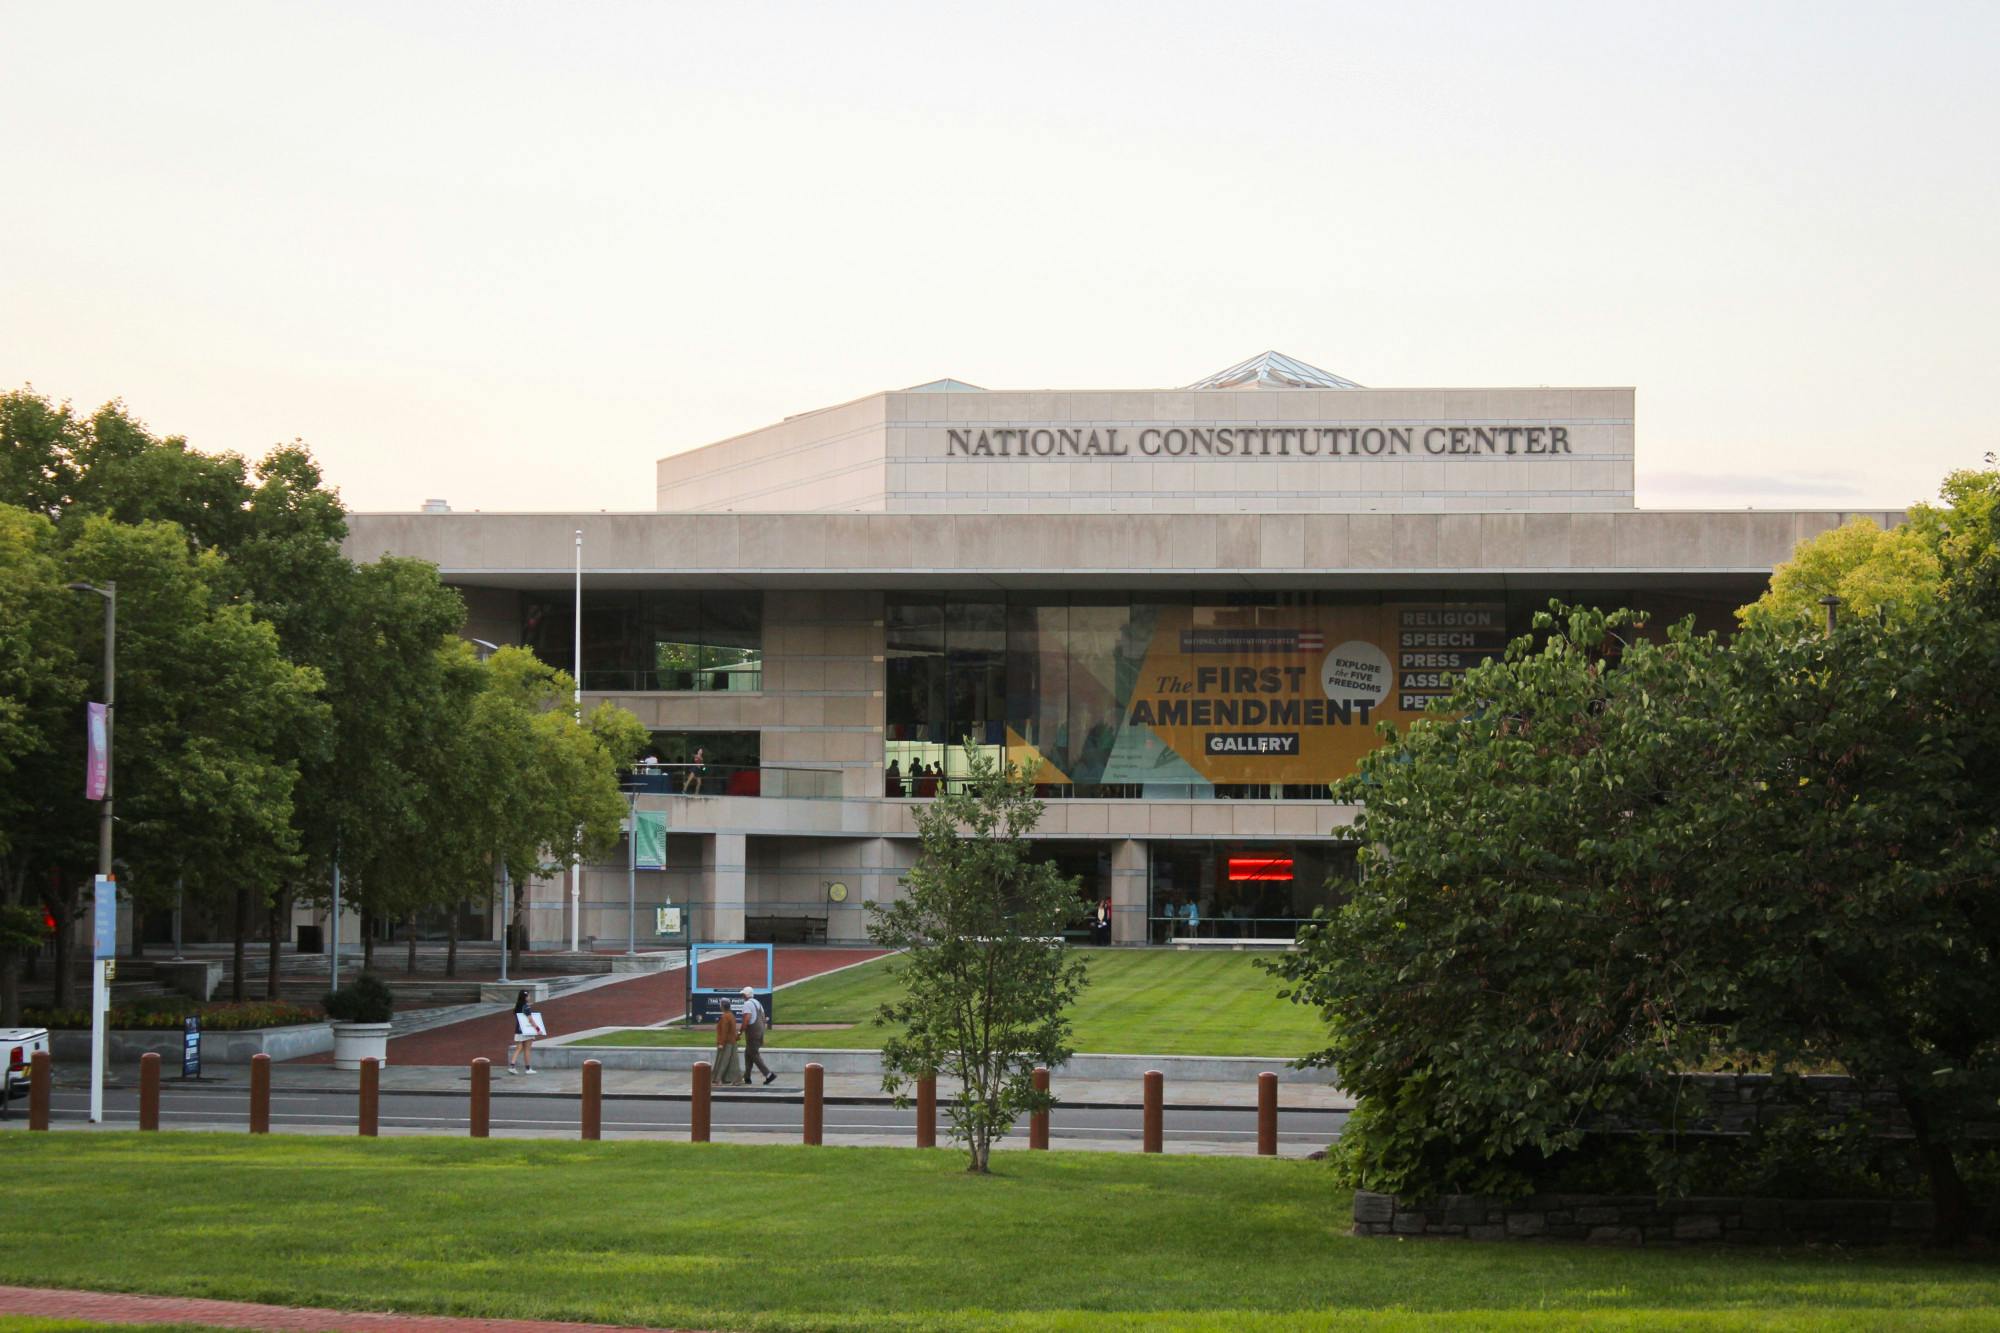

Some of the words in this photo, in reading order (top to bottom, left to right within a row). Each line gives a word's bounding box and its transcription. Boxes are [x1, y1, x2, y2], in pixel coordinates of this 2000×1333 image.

[946, 429, 1128, 456] NATIONAL
[1138, 428, 1413, 456] CONSTITUTION
[1423, 427, 1572, 455] CENTER
[1403, 611, 1491, 625] RELIGION
[1402, 633, 1475, 646] SPEECH
[1335, 659, 1382, 673] EXPLORE
[1402, 654, 1460, 667] PRESS
[1155, 676, 1192, 694] The
[1197, 666, 1306, 693] FIRST
[1335, 670, 1349, 678] the
[1350, 671, 1373, 682] FIVE
[1328, 677, 1382, 693] FREEDOMS
[1129, 699, 1376, 726] AMENDMENT
[1210, 737, 1293, 751] GALLERY
